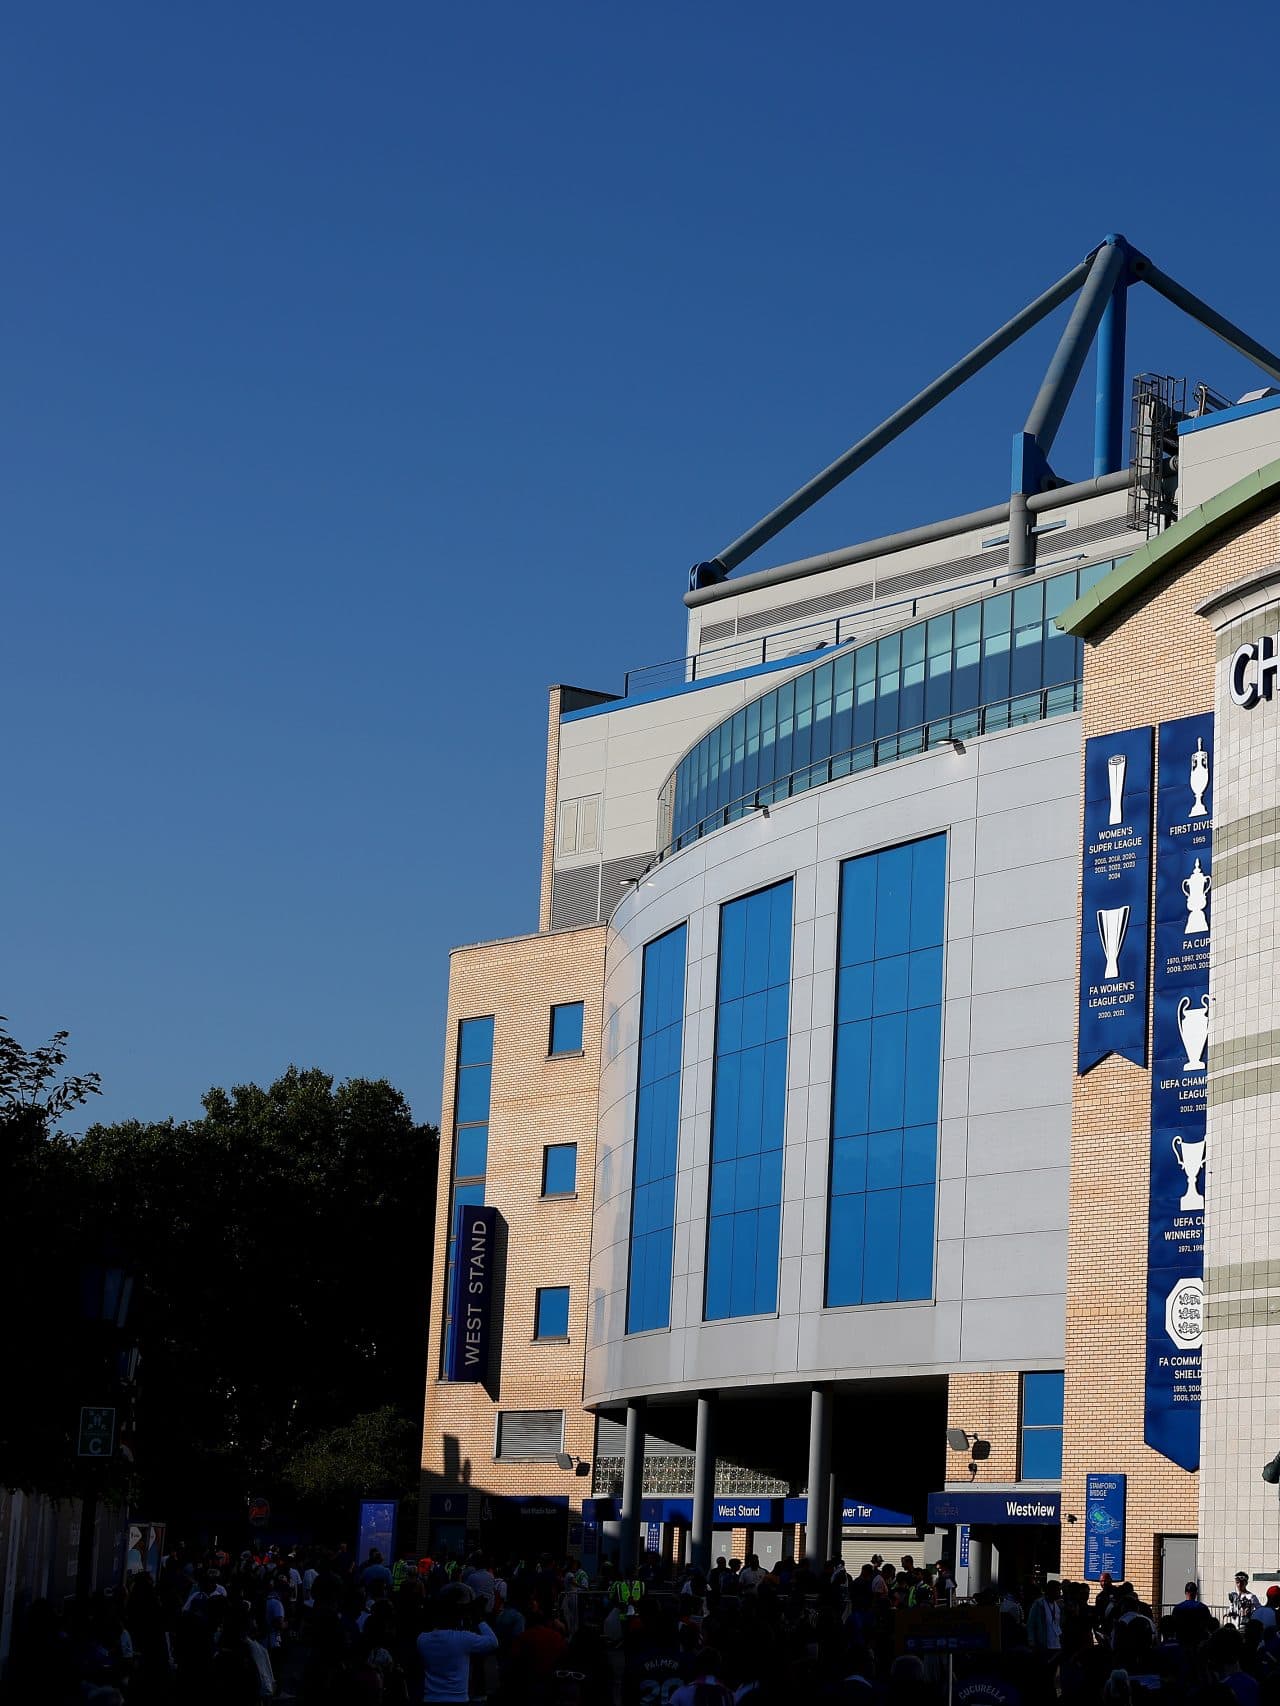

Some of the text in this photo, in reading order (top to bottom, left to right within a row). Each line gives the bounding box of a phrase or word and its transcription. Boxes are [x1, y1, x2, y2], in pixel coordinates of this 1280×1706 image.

[1098, 826, 1133, 841] WOMEN'S
[1169, 823, 1191, 836] FIRST
[1088, 837, 1143, 854] SUPER LEAGUE
[1182, 937, 1210, 950] FA CUP
[1089, 981, 1135, 995] FA WOMEN'S
[1088, 993, 1135, 1008] LEAGUE CUP
[1160, 1079, 1180, 1090] UEFA
[1173, 1217, 1194, 1227] UEFA
[1164, 1229, 1203, 1241] WINNERS'
[464, 1219, 487, 1367] WEST STAND
[1158, 1356, 1202, 1367] FA COMMU
[1174, 1369, 1202, 1379] SHIELD
[1089, 1482, 1117, 1490] STAMFORD
[718, 1503, 760, 1517] West Stand
[857, 1505, 873, 1518] Tier
[1006, 1501, 1056, 1517] Westview
